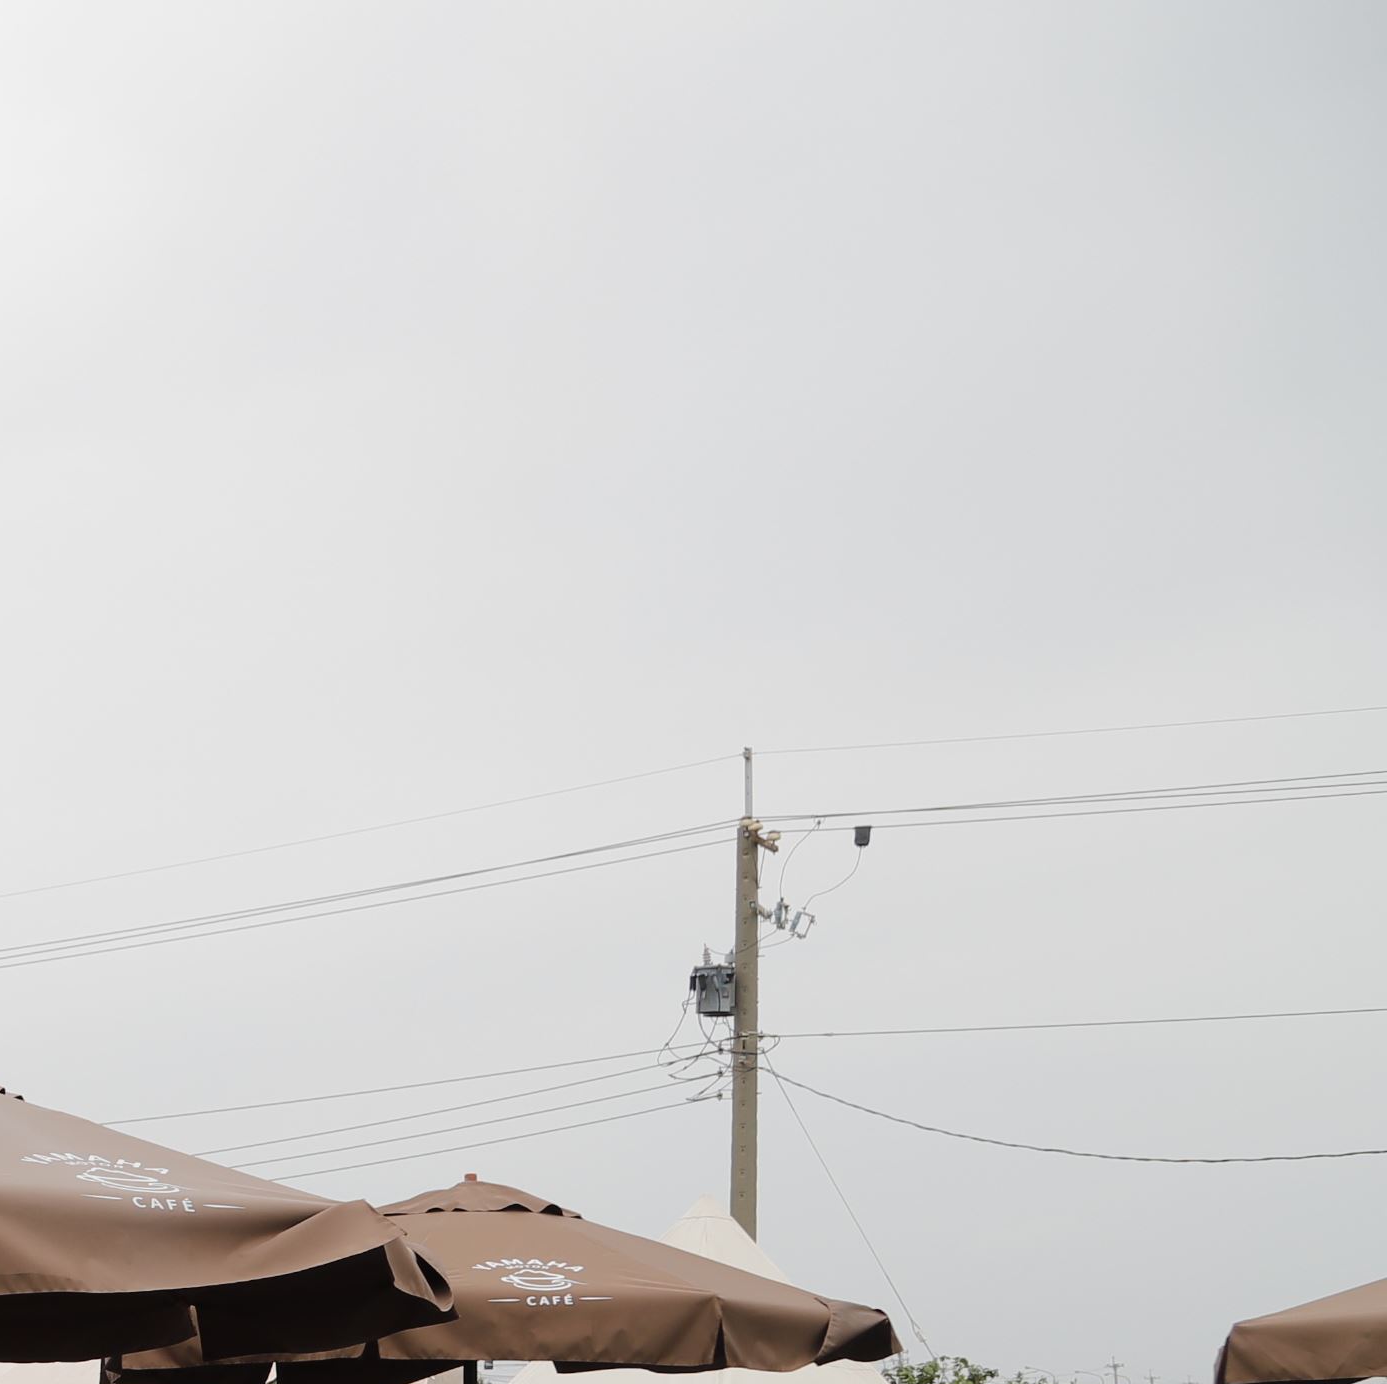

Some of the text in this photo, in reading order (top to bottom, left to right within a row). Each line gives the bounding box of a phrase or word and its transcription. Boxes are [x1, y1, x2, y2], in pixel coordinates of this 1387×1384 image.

[20, 1152, 169, 1174] YAMAHA
[132, 1196, 196, 1213] CAFÉ
[471, 1258, 584, 1272] YAMAHA
[526, 1293, 573, 1306] CAFÉ
